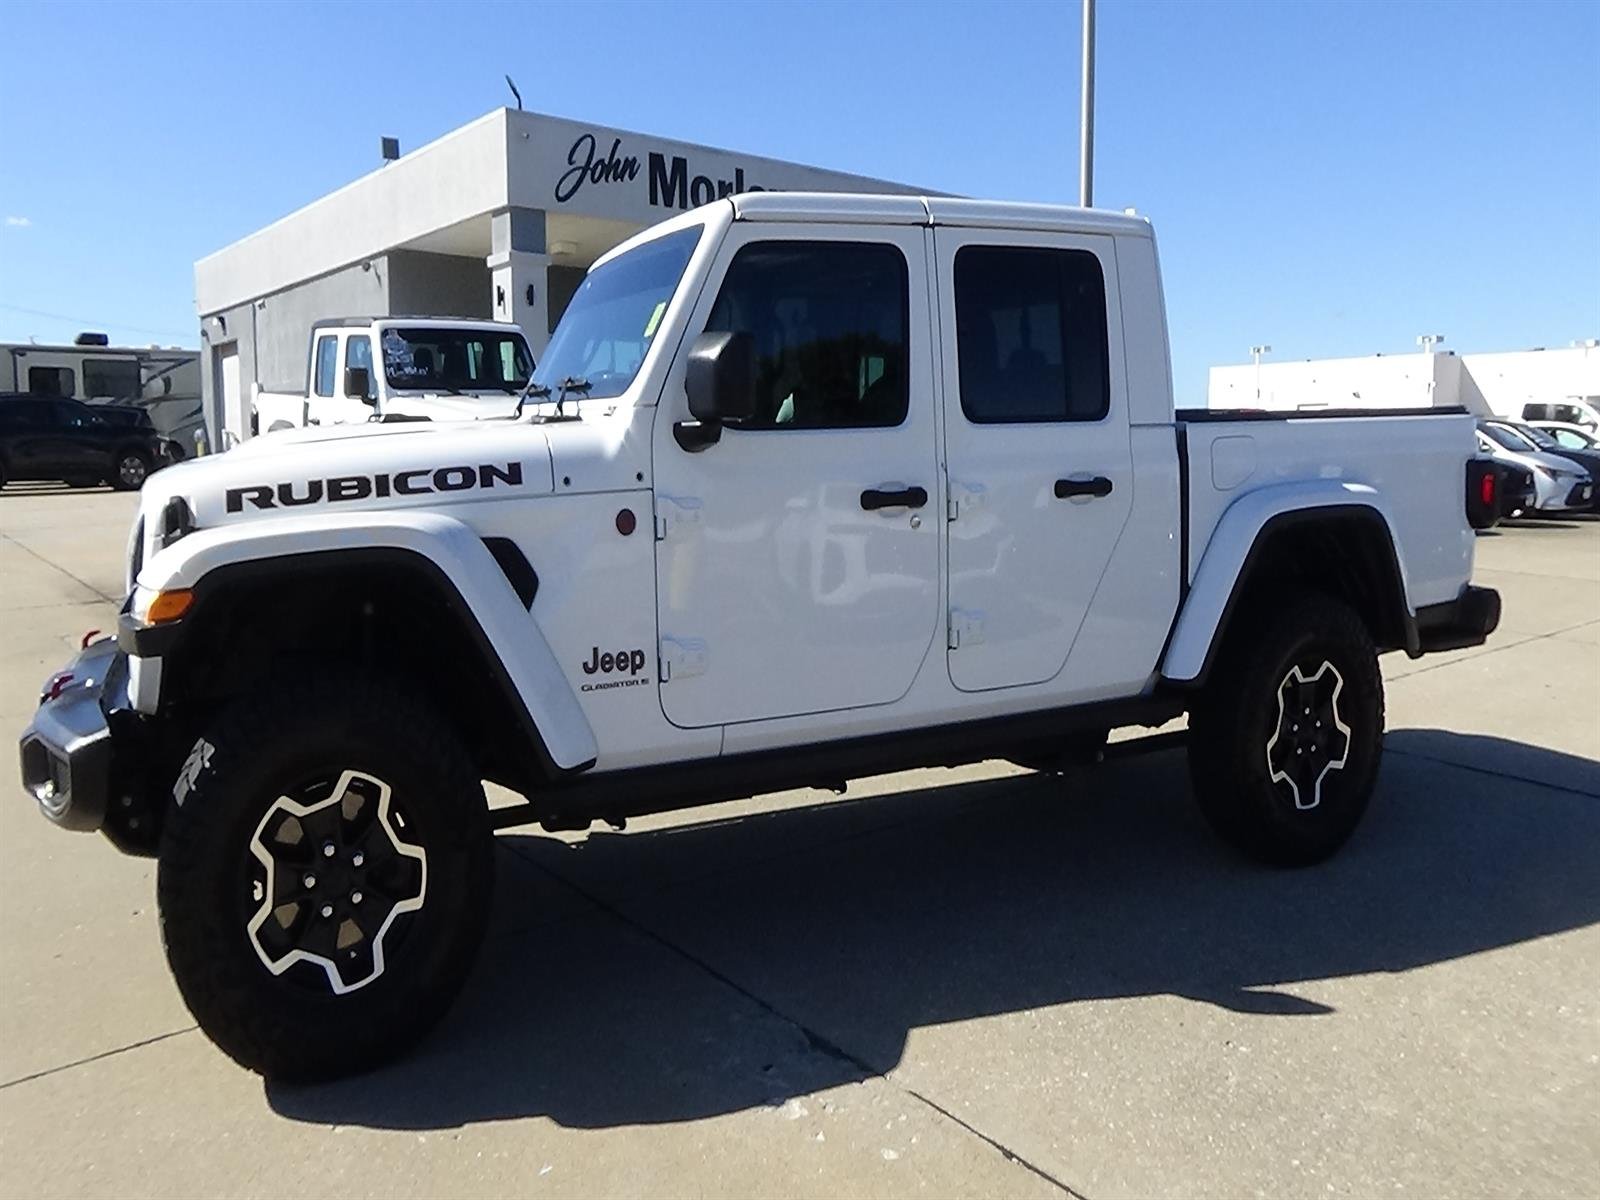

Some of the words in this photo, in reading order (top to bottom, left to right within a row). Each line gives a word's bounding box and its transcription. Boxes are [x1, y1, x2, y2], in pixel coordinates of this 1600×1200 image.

[555, 133, 641, 202] John
[225, 461, 523, 514] RUBICON
[582, 646, 645, 676] Jeep
